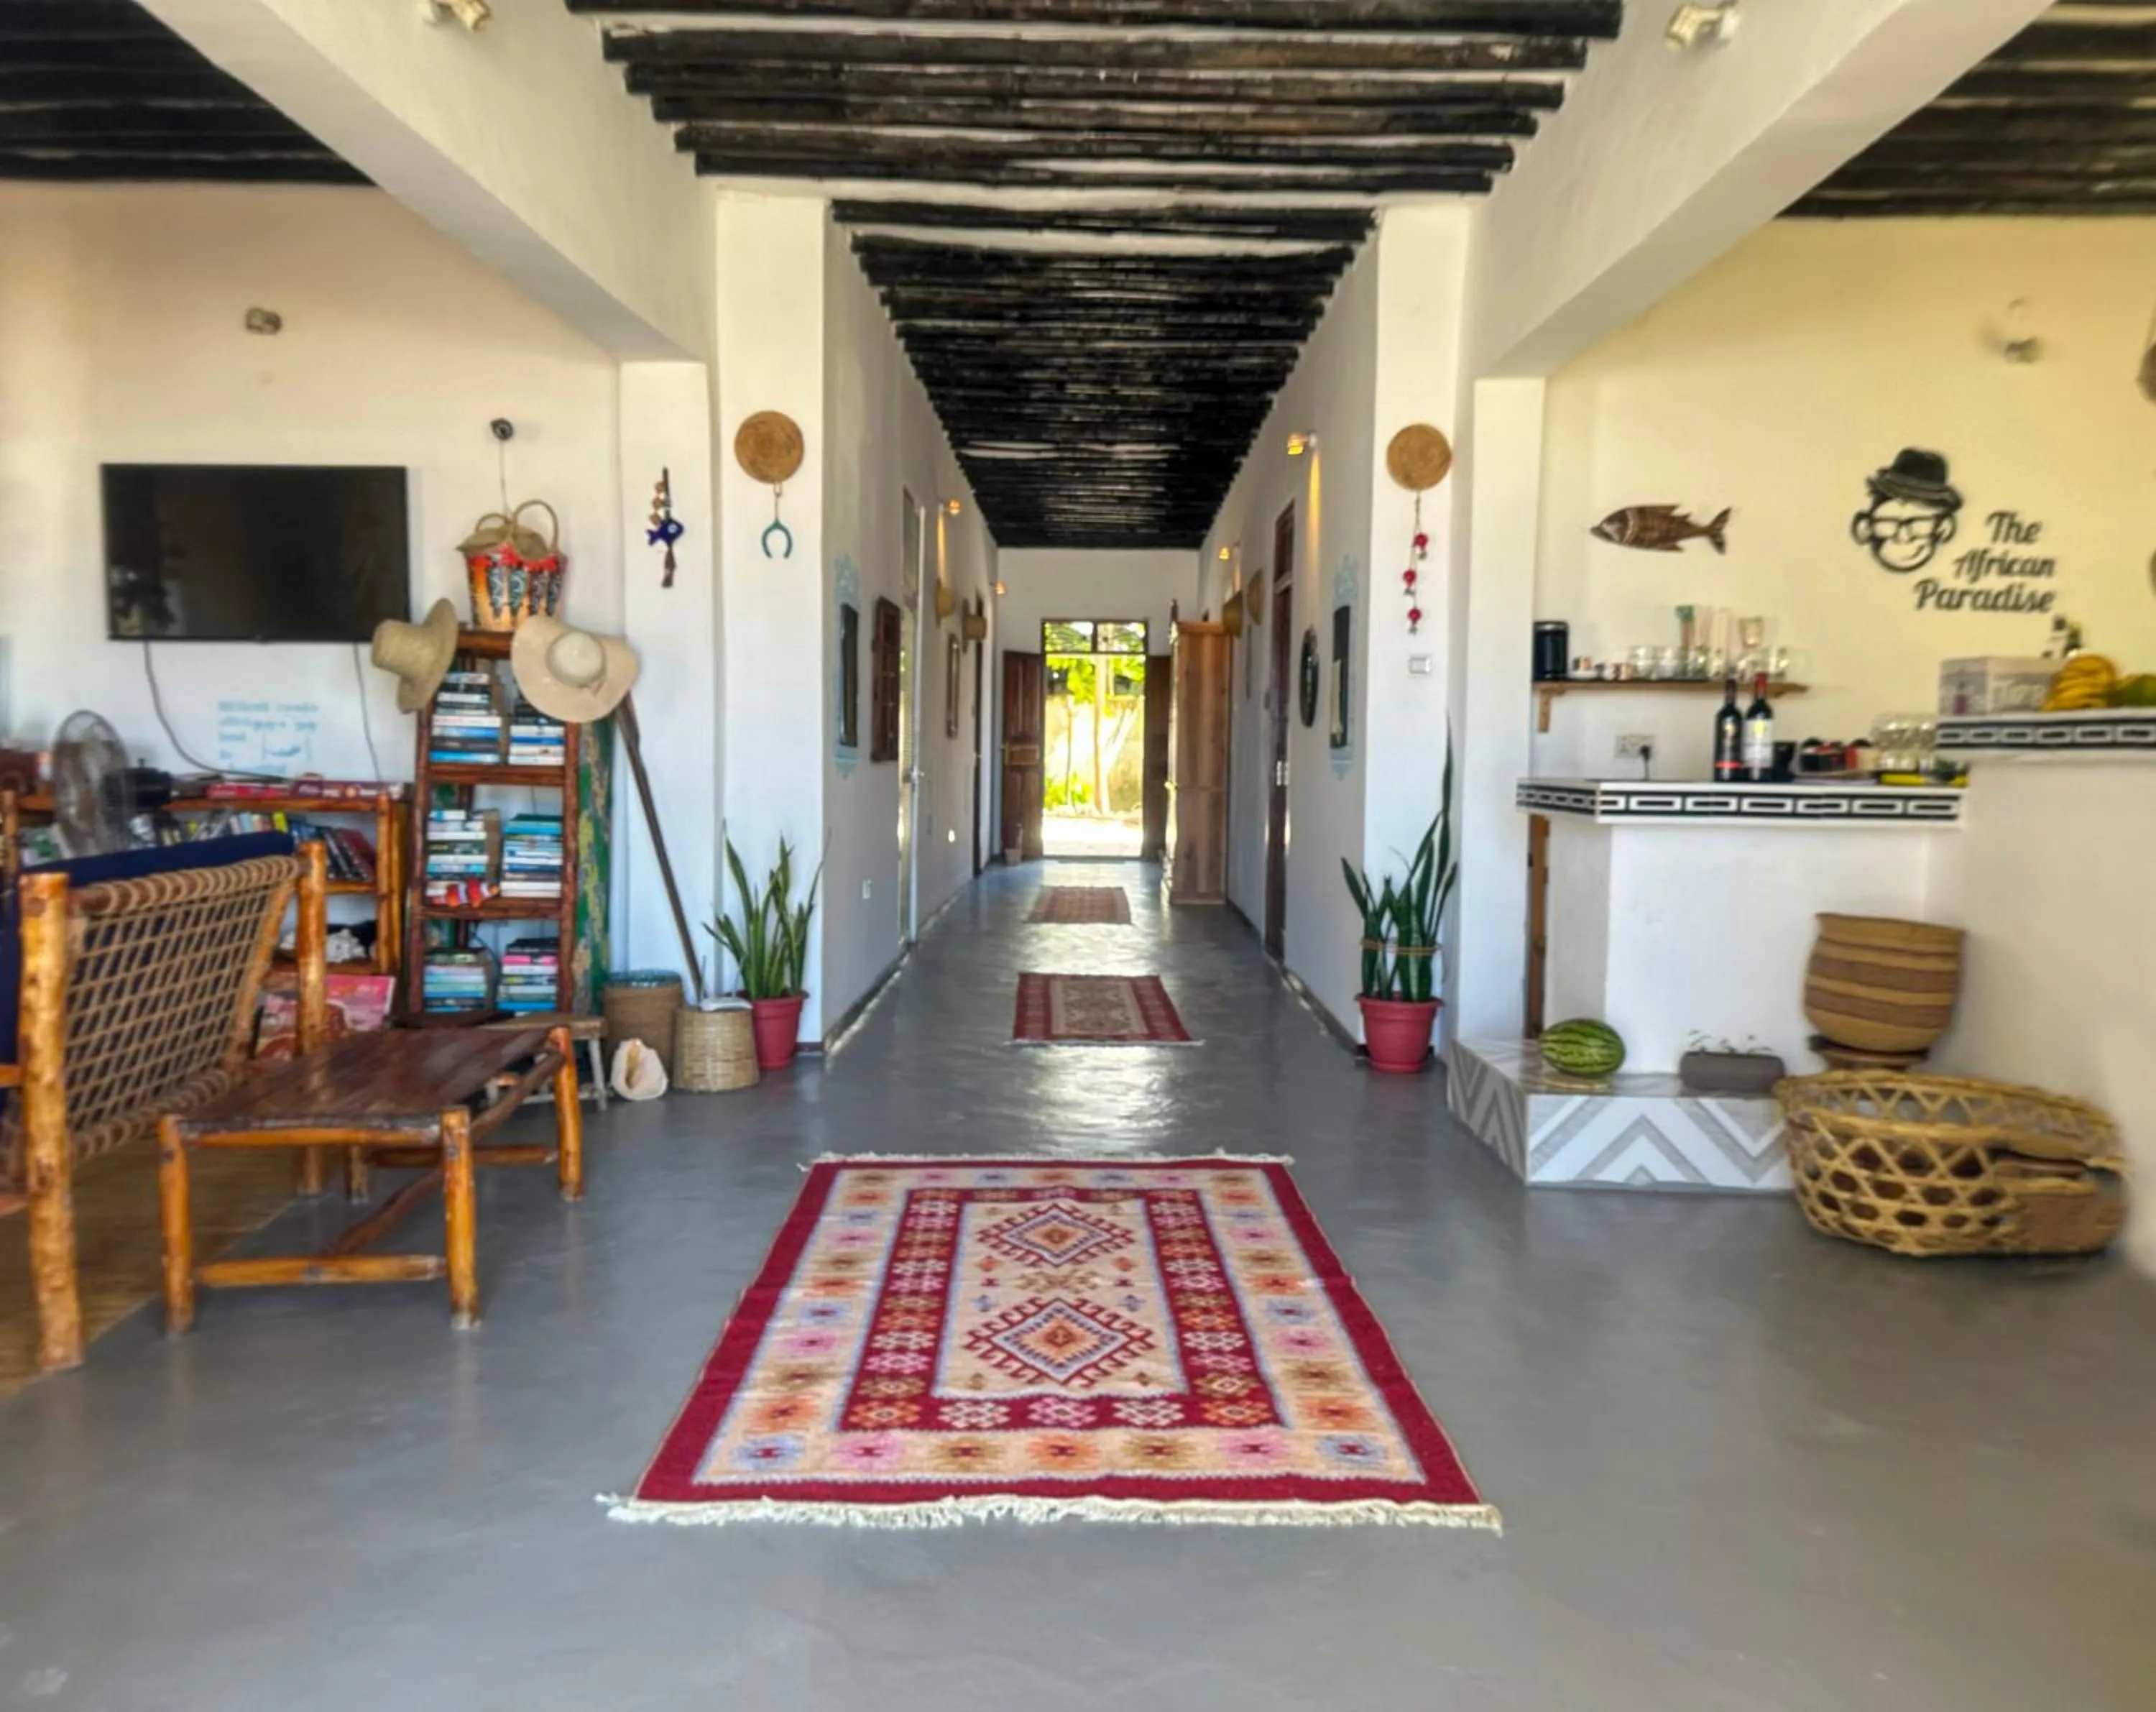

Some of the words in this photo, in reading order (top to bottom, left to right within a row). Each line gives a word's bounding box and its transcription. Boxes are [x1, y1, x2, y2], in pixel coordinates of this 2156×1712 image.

[1986, 511, 2042, 543] The
[1952, 548, 2056, 583] African
[1915, 578, 2057, 612] Paradise
